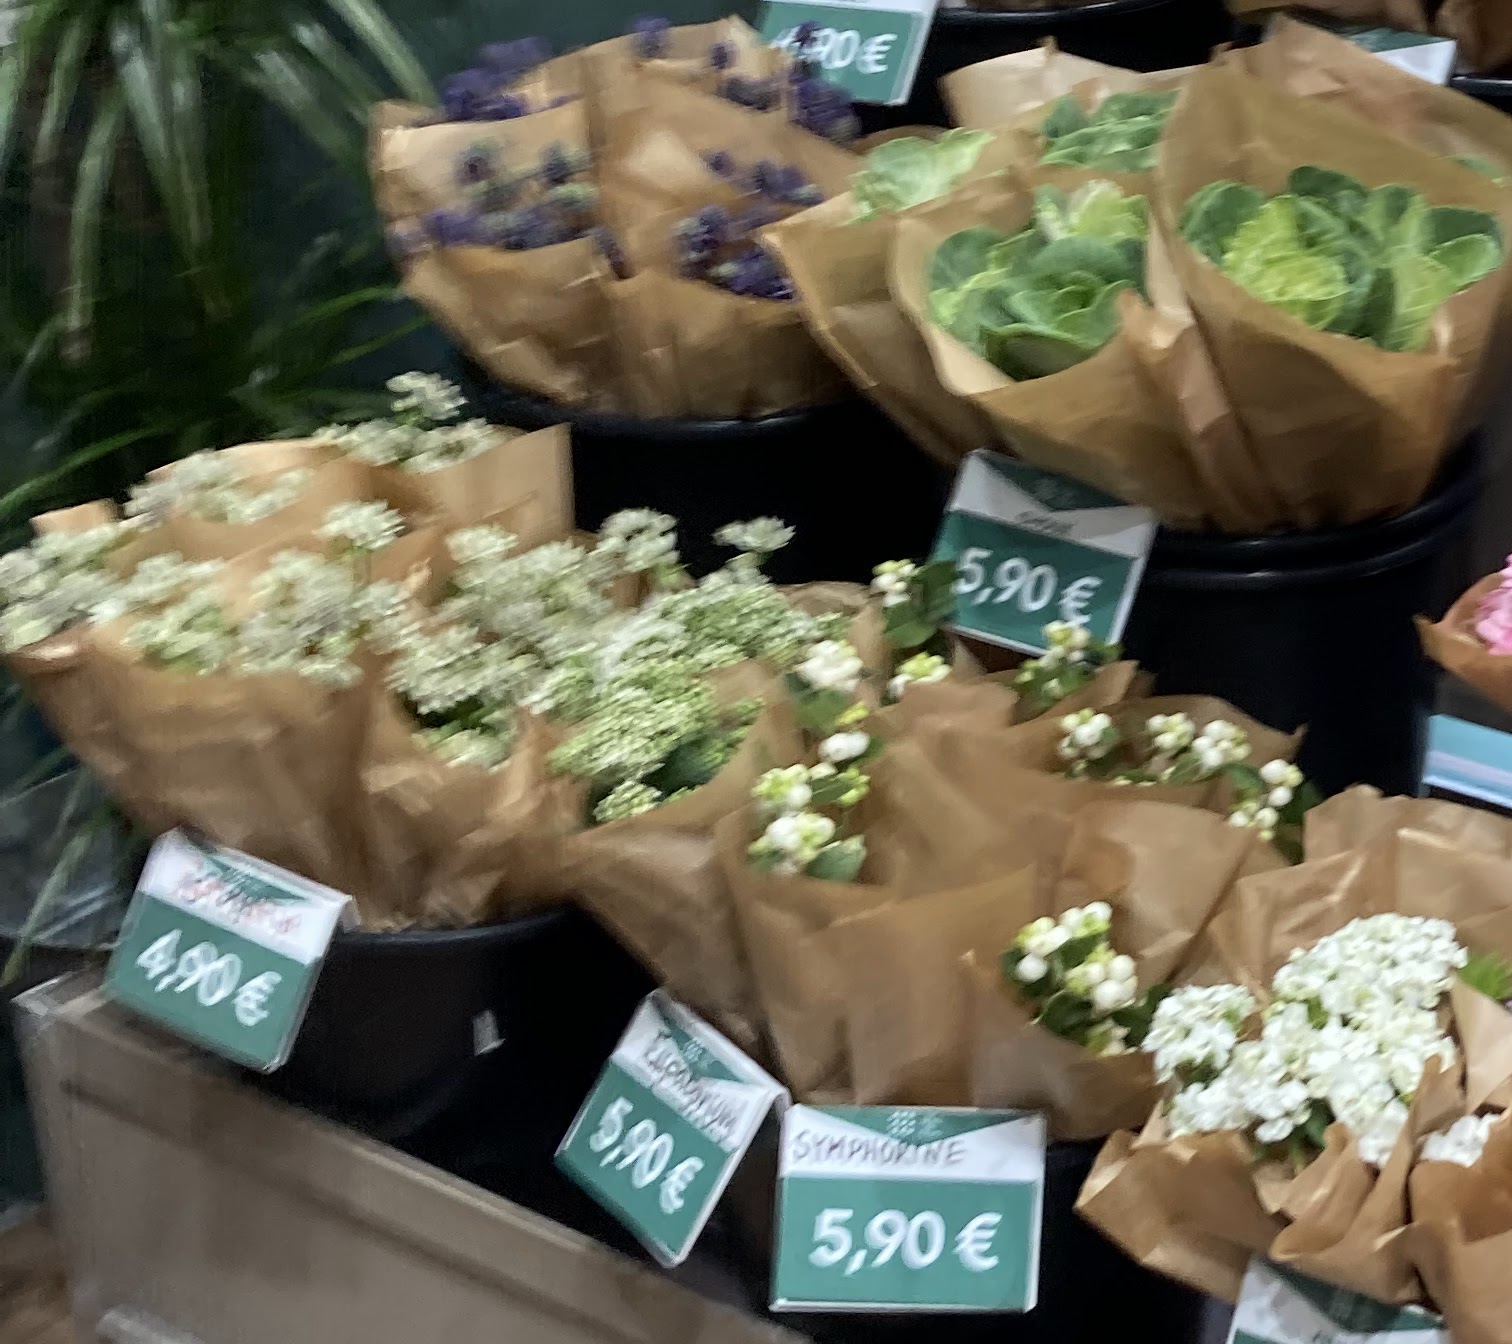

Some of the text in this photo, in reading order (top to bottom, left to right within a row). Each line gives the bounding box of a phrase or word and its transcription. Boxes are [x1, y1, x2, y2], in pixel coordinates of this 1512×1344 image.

[856, 32, 898, 75] €
[951, 546, 1104, 628] 5,90 €
[134, 928, 283, 1028] 4,90 €
[588, 1096, 705, 1215] 5,90 €
[807, 1207, 1003, 1278] 5,90 €
